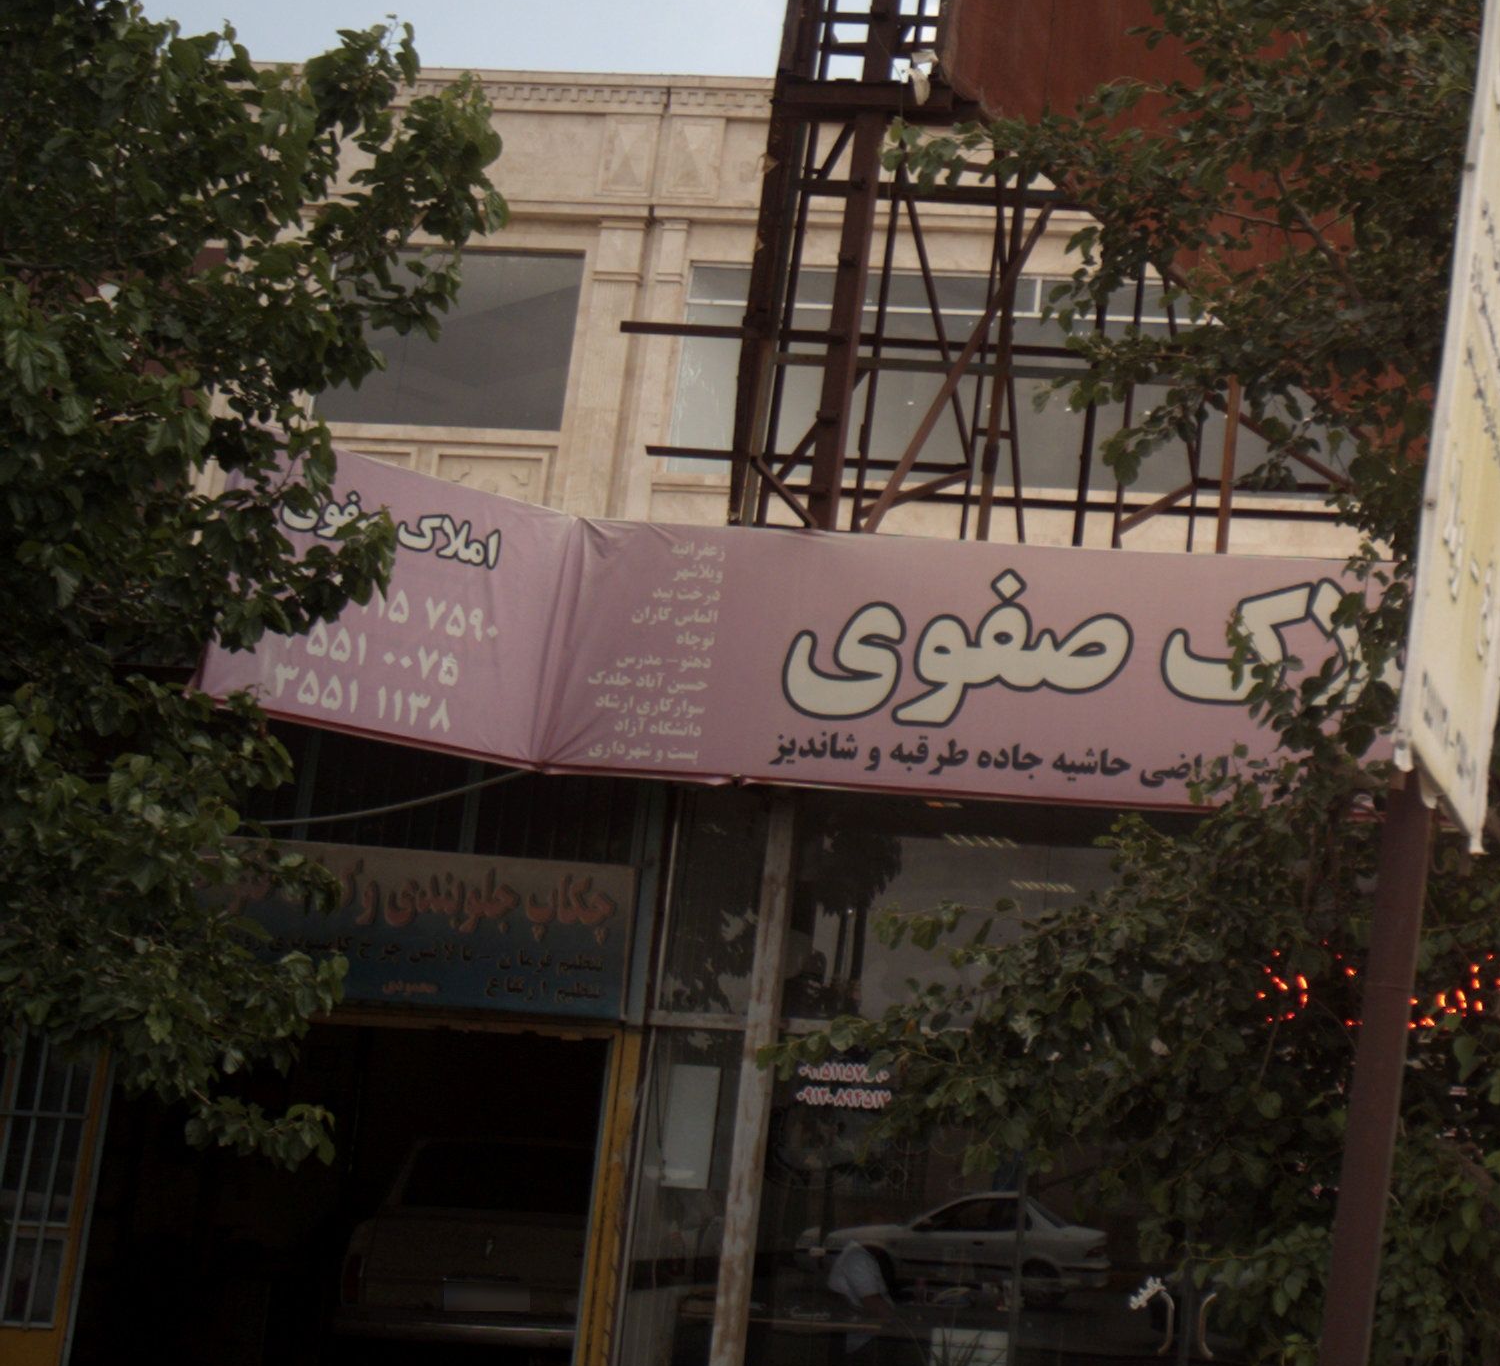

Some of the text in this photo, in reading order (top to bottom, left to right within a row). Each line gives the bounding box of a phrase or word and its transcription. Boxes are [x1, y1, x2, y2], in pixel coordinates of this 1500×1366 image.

[279, 490, 501, 570] املاک فوی
[671, 541, 726, 562] زعفرانیه
[652, 587, 721, 606] درخت بید
[425, 595, 499, 643] ۷۵۹۰
[631, 604, 719, 626] الماس کاران
[284, 615, 459, 687] ۵۵۱ ۰۰۷۵
[616, 654, 663, 669] مدرس
[781, 568, 1134, 727] صفوی
[275, 662, 451, 733] ۳۵۵۱ ۱۱۳۸
[635, 672, 665, 691] آباد
[667, 679, 708, 695] حسین
[614, 717, 702, 738] دانشگاه آزاد
[588, 740, 698, 765] پست و شهرداری
[768, 730, 858, 766] شاندیز
[864, 741, 882, 771] و
[889, 735, 969, 775] طرقبه
[976, 743, 1043, 780] جاده
[1052, 747, 1132, 782] حاشیه
